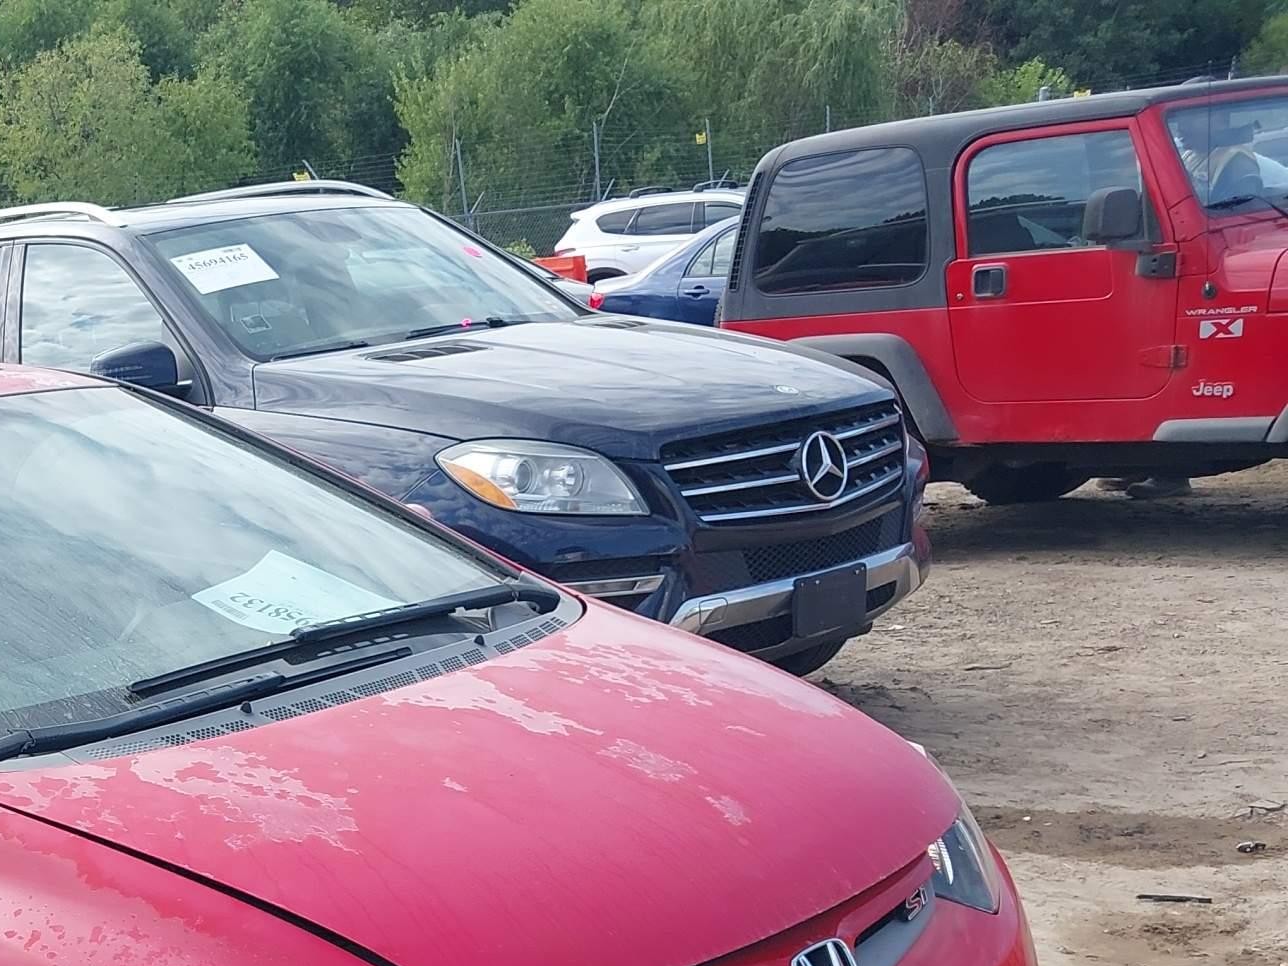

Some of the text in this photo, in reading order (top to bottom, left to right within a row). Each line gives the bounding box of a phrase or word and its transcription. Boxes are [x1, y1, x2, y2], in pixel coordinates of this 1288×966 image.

[187, 252, 249, 272] 45694165
[1185, 305, 1258, 316] WRANGLER
[1200, 318, 1243, 339] X
[1191, 379, 1234, 399] Jeep
[230, 591, 314, 627] 958132
